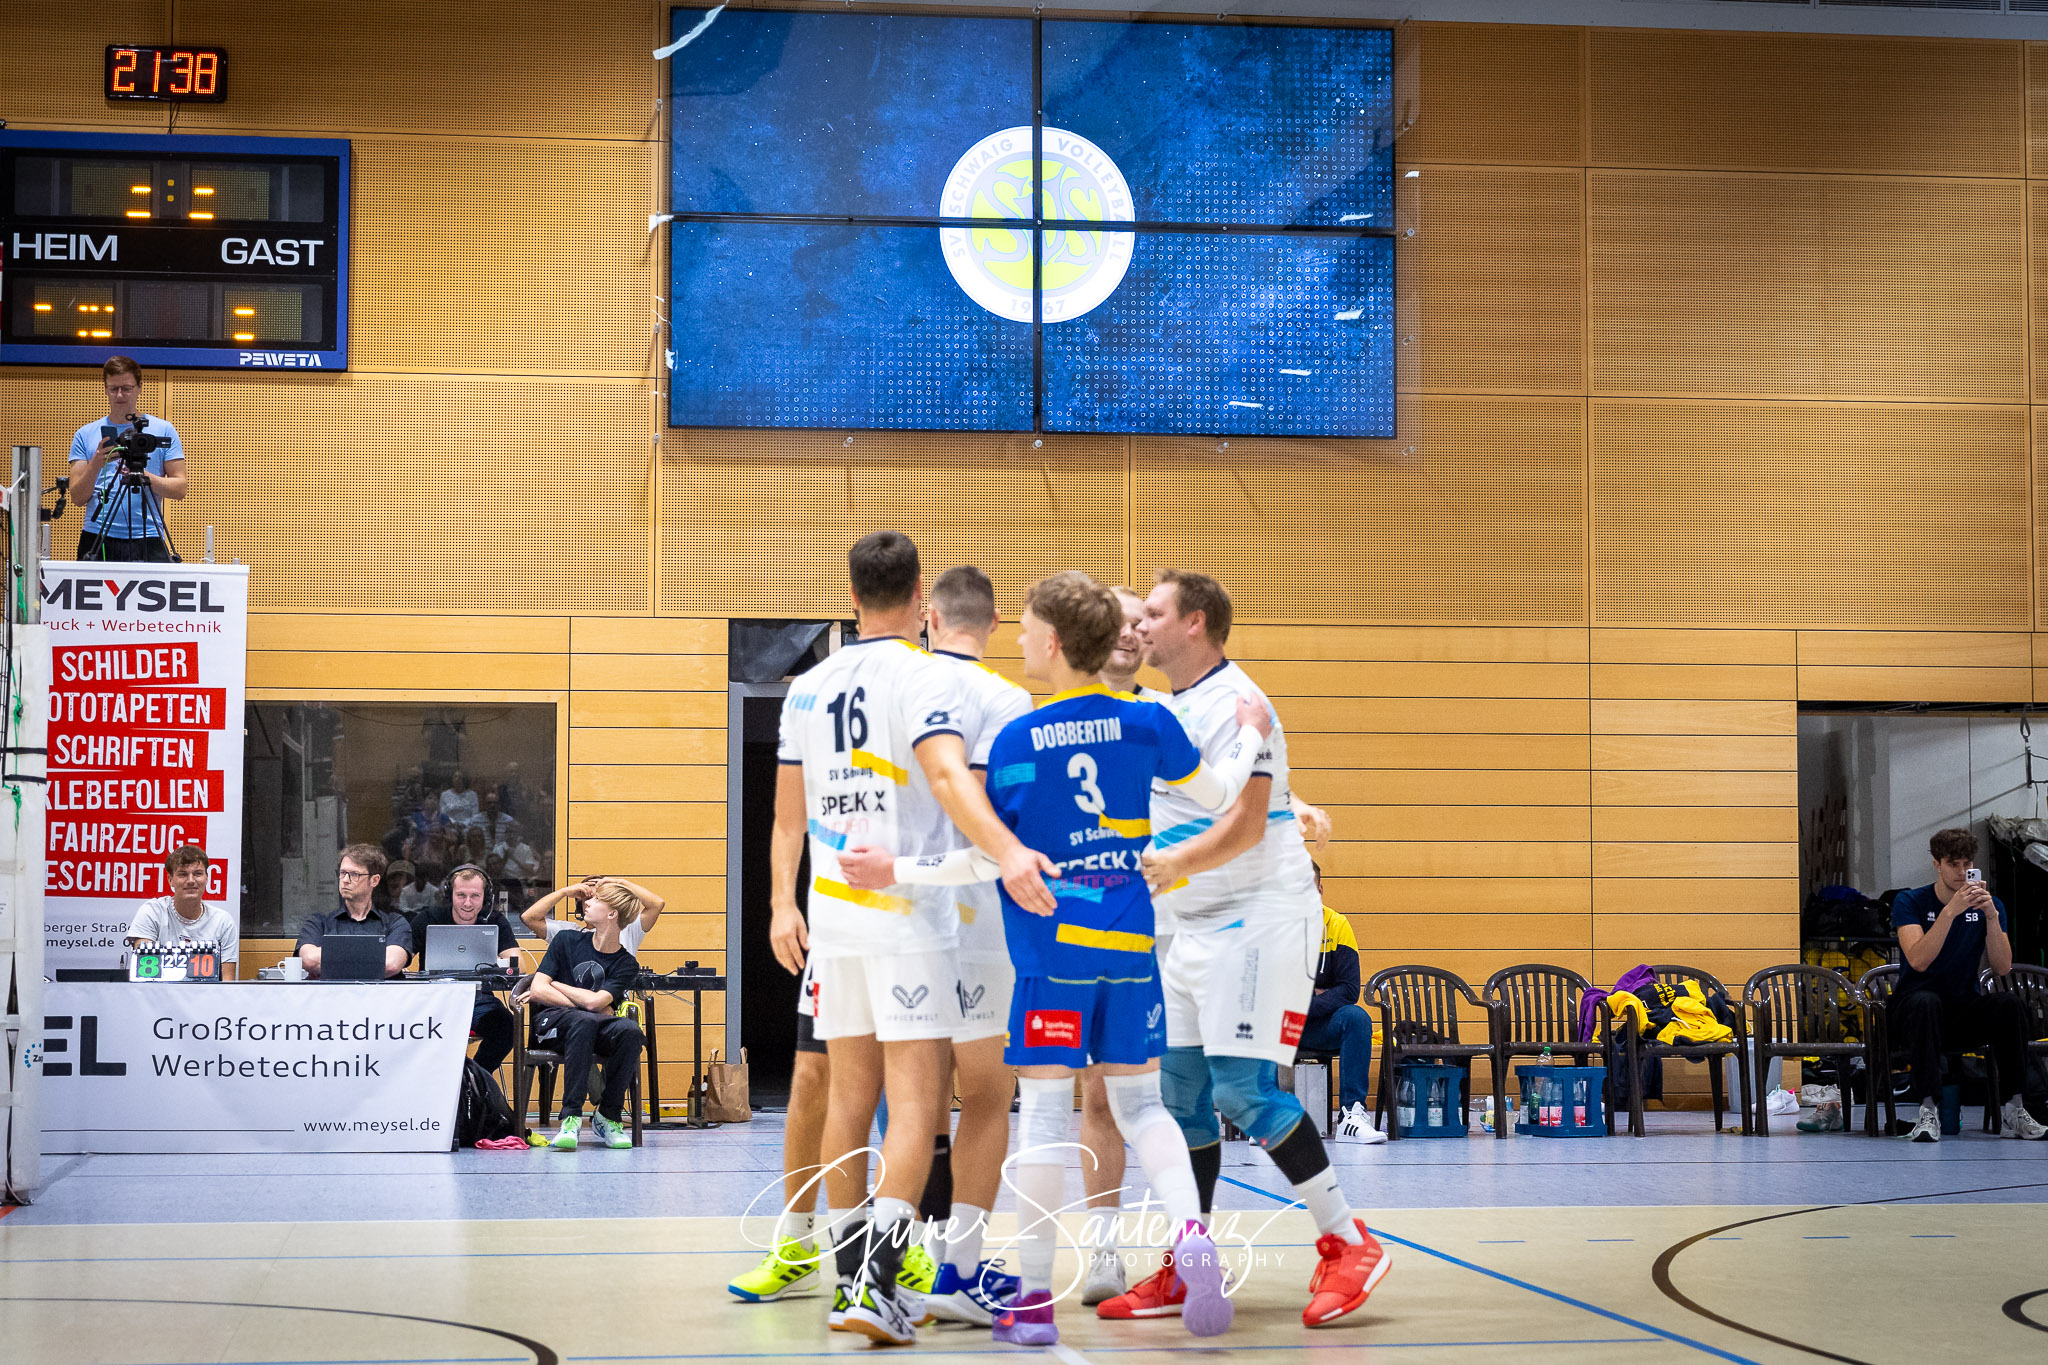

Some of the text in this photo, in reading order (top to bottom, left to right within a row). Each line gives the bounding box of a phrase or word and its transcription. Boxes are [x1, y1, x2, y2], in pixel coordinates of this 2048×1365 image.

[948, 138, 1127, 261] SV SCHWAIG VOLLEYBALL
[13, 232, 119, 262] HEIM
[221, 237, 324, 266] GAST
[1011, 299, 1065, 315] 1967
[239, 352, 323, 367] PEWETA
[102, 619, 222, 634] Werbetechnik
[61, 648, 188, 682] SCHILDER
[827, 686, 869, 753] 16
[1030, 717, 1122, 751] DOBBERTIN
[54, 734, 194, 769] SCHRIFTEN
[1067, 752, 1106, 815] 3
[50, 821, 200, 854] FAHRZEUG-
[1069, 830, 1084, 846] SV
[91, 922, 131, 933] Straß
[1965, 912, 1979, 922] SB
[138, 955, 160, 977] 8
[190, 954, 214, 977] 10
[152, 1016, 444, 1041] Großformatdruck
[151, 1053, 381, 1078] Werbetechnik
[303, 1117, 441, 1135] www.meysel.de
